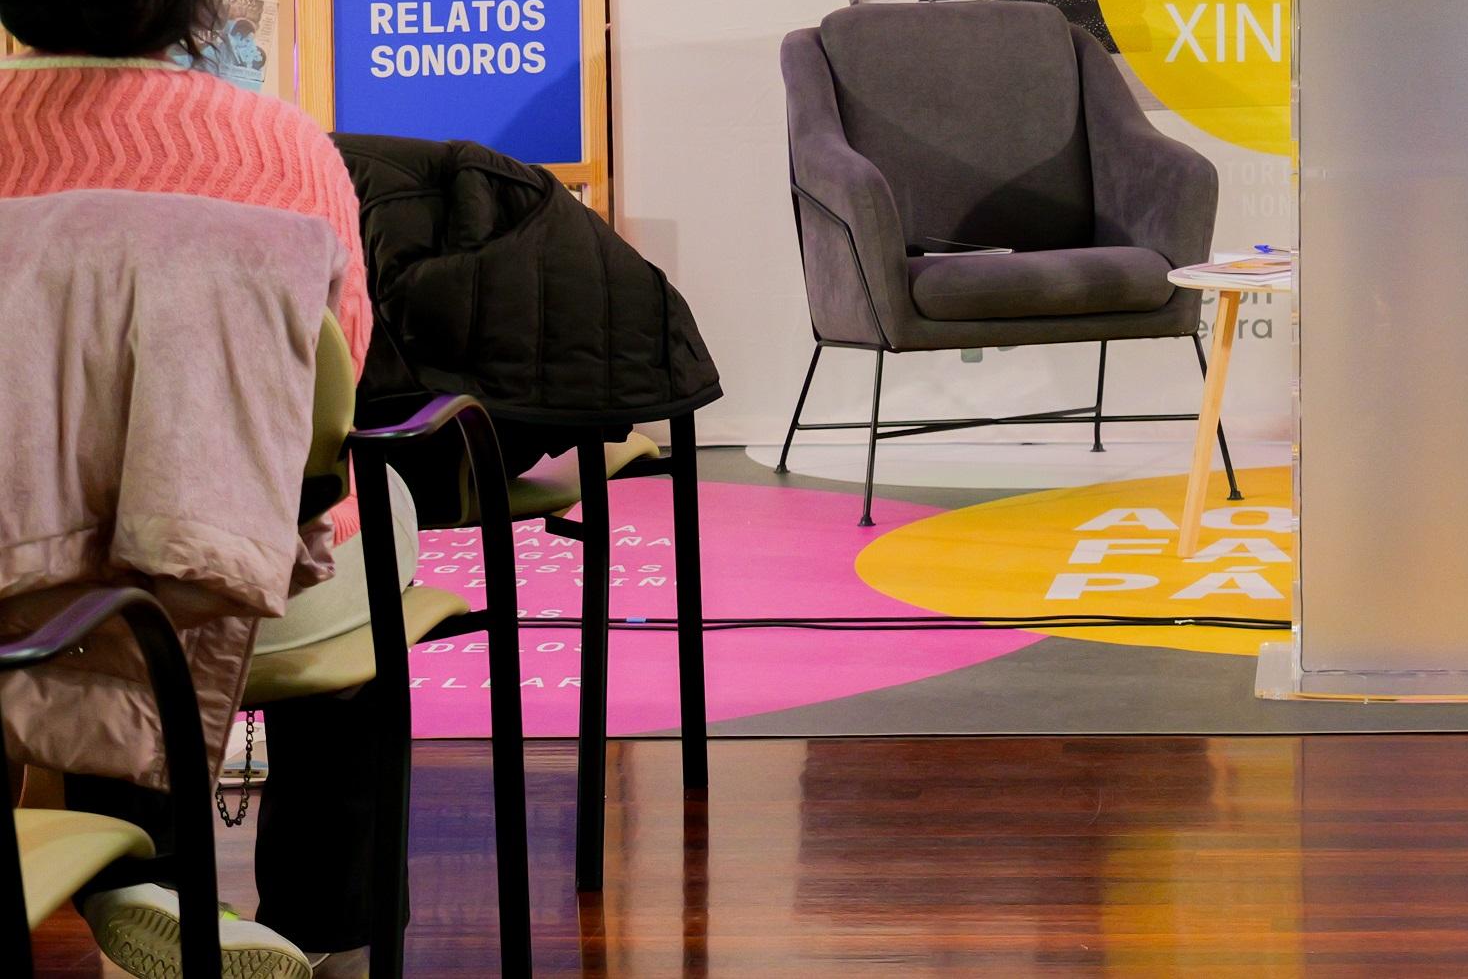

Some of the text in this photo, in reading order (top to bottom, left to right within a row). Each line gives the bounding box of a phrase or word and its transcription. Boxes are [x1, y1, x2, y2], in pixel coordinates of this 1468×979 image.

[370, 0, 546, 35] RELATOS
[1164, 3, 1282, 62] XIN
[370, 41, 546, 79] SONOROS
